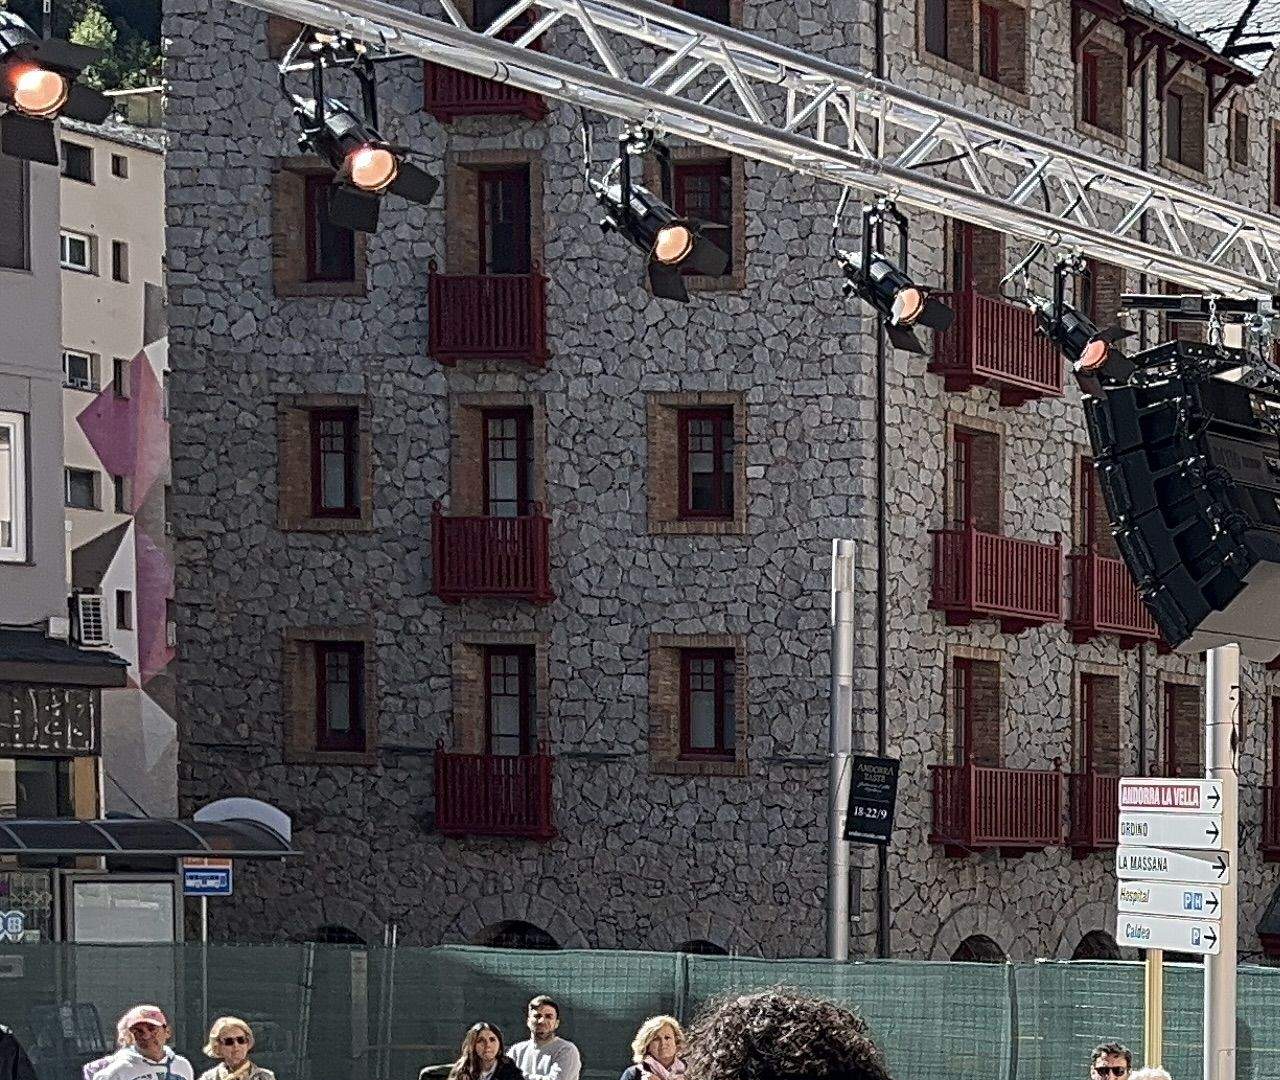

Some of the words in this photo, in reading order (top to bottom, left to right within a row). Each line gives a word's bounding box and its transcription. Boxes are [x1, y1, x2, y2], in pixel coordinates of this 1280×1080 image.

[1122, 786, 1160, 805] ANDORRA
[1161, 787, 1173, 806] LA
[1173, 787, 1199, 807] VELLA
[1121, 822, 1148, 837] ORDINO
[1118, 855, 1128, 870] LA
[1130, 855, 1168, 872] MASSANA
[1120, 888, 1151, 906] Hospital
[1126, 922, 1151, 940] Caldea
